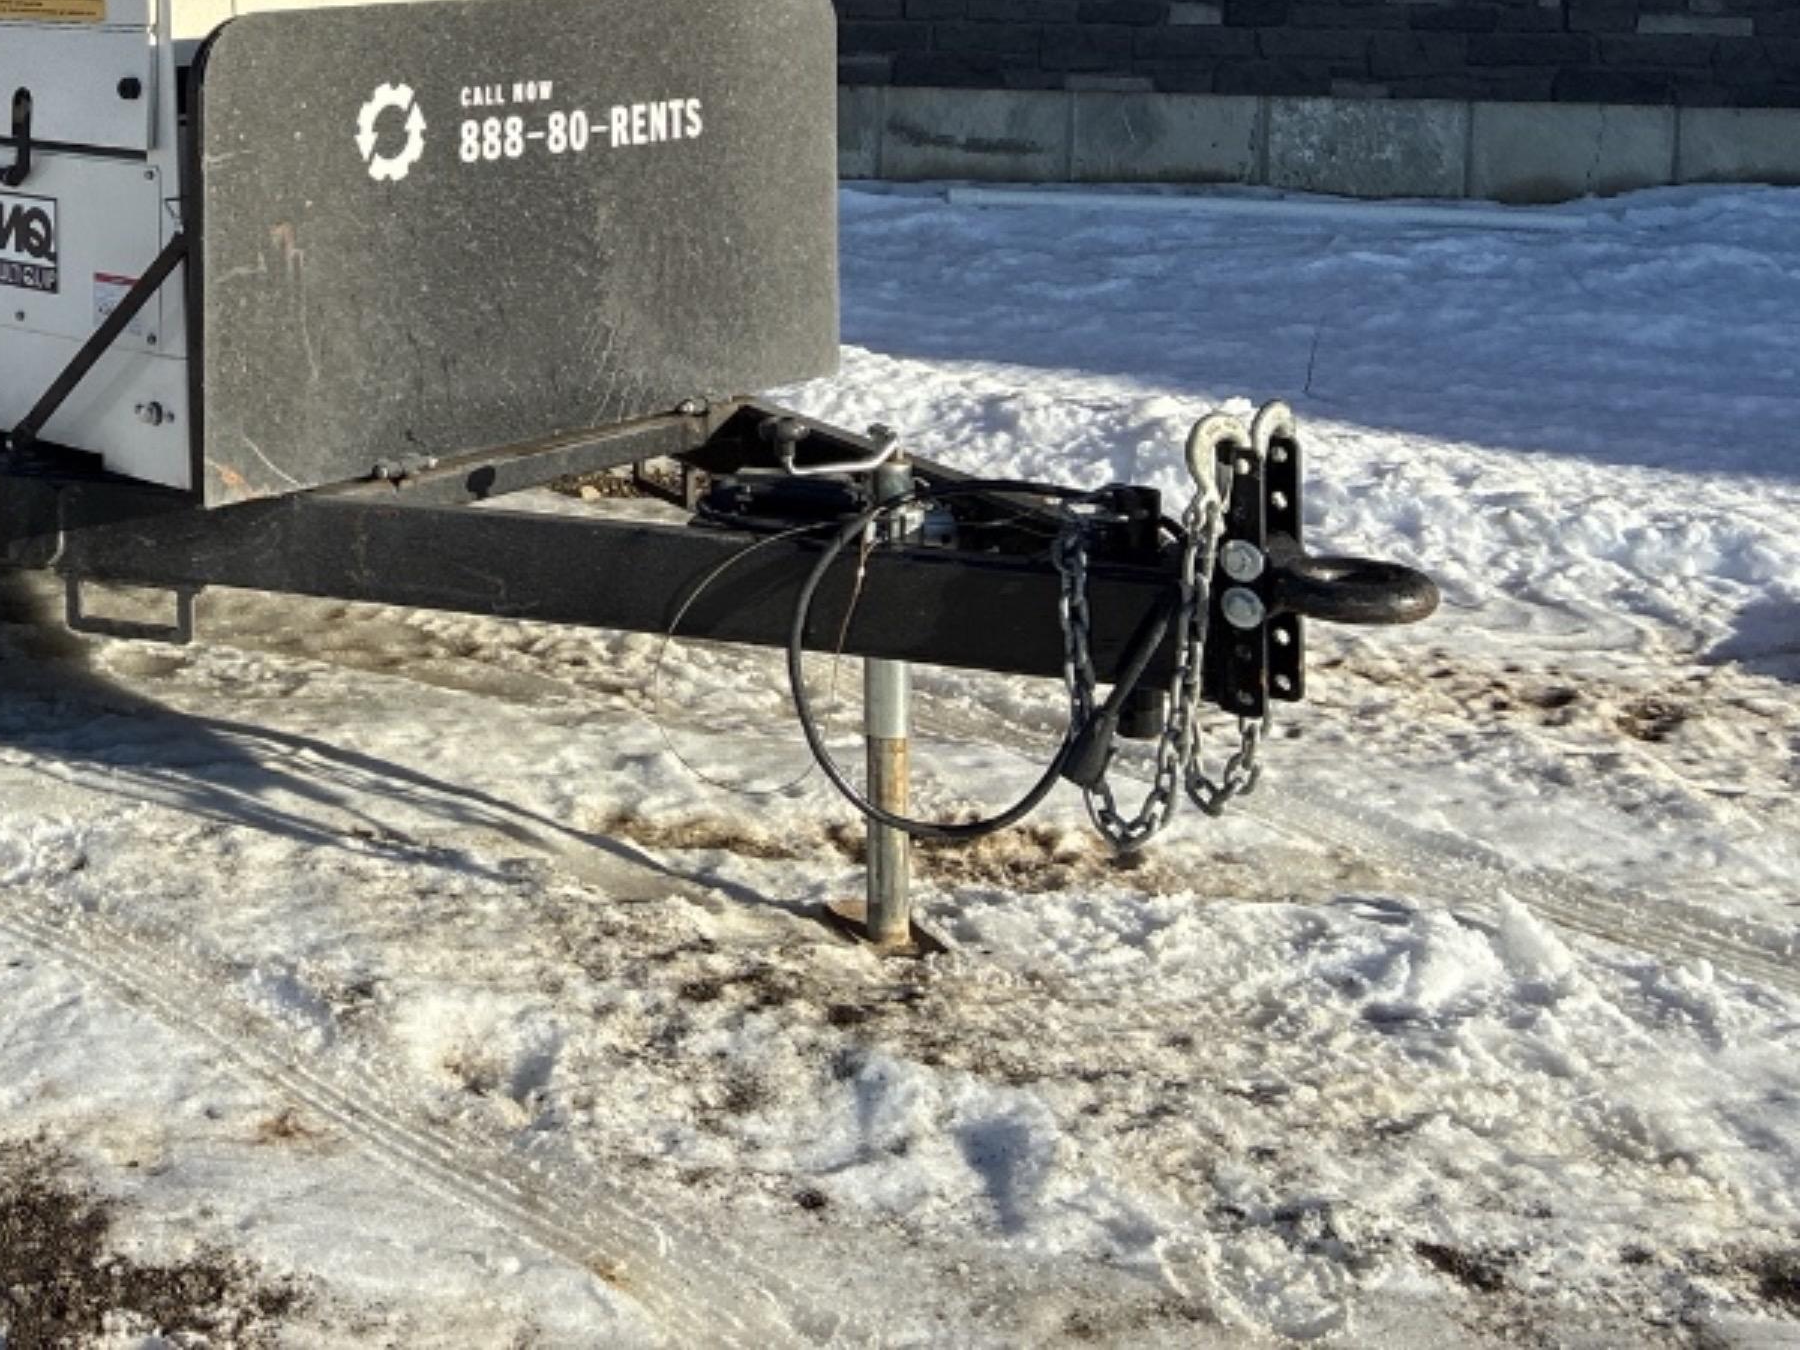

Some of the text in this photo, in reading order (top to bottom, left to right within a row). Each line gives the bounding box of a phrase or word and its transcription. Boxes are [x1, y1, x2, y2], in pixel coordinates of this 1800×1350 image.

[459, 79, 554, 108] CALL NOW
[458, 97, 704, 164] 888-80-RENTS
